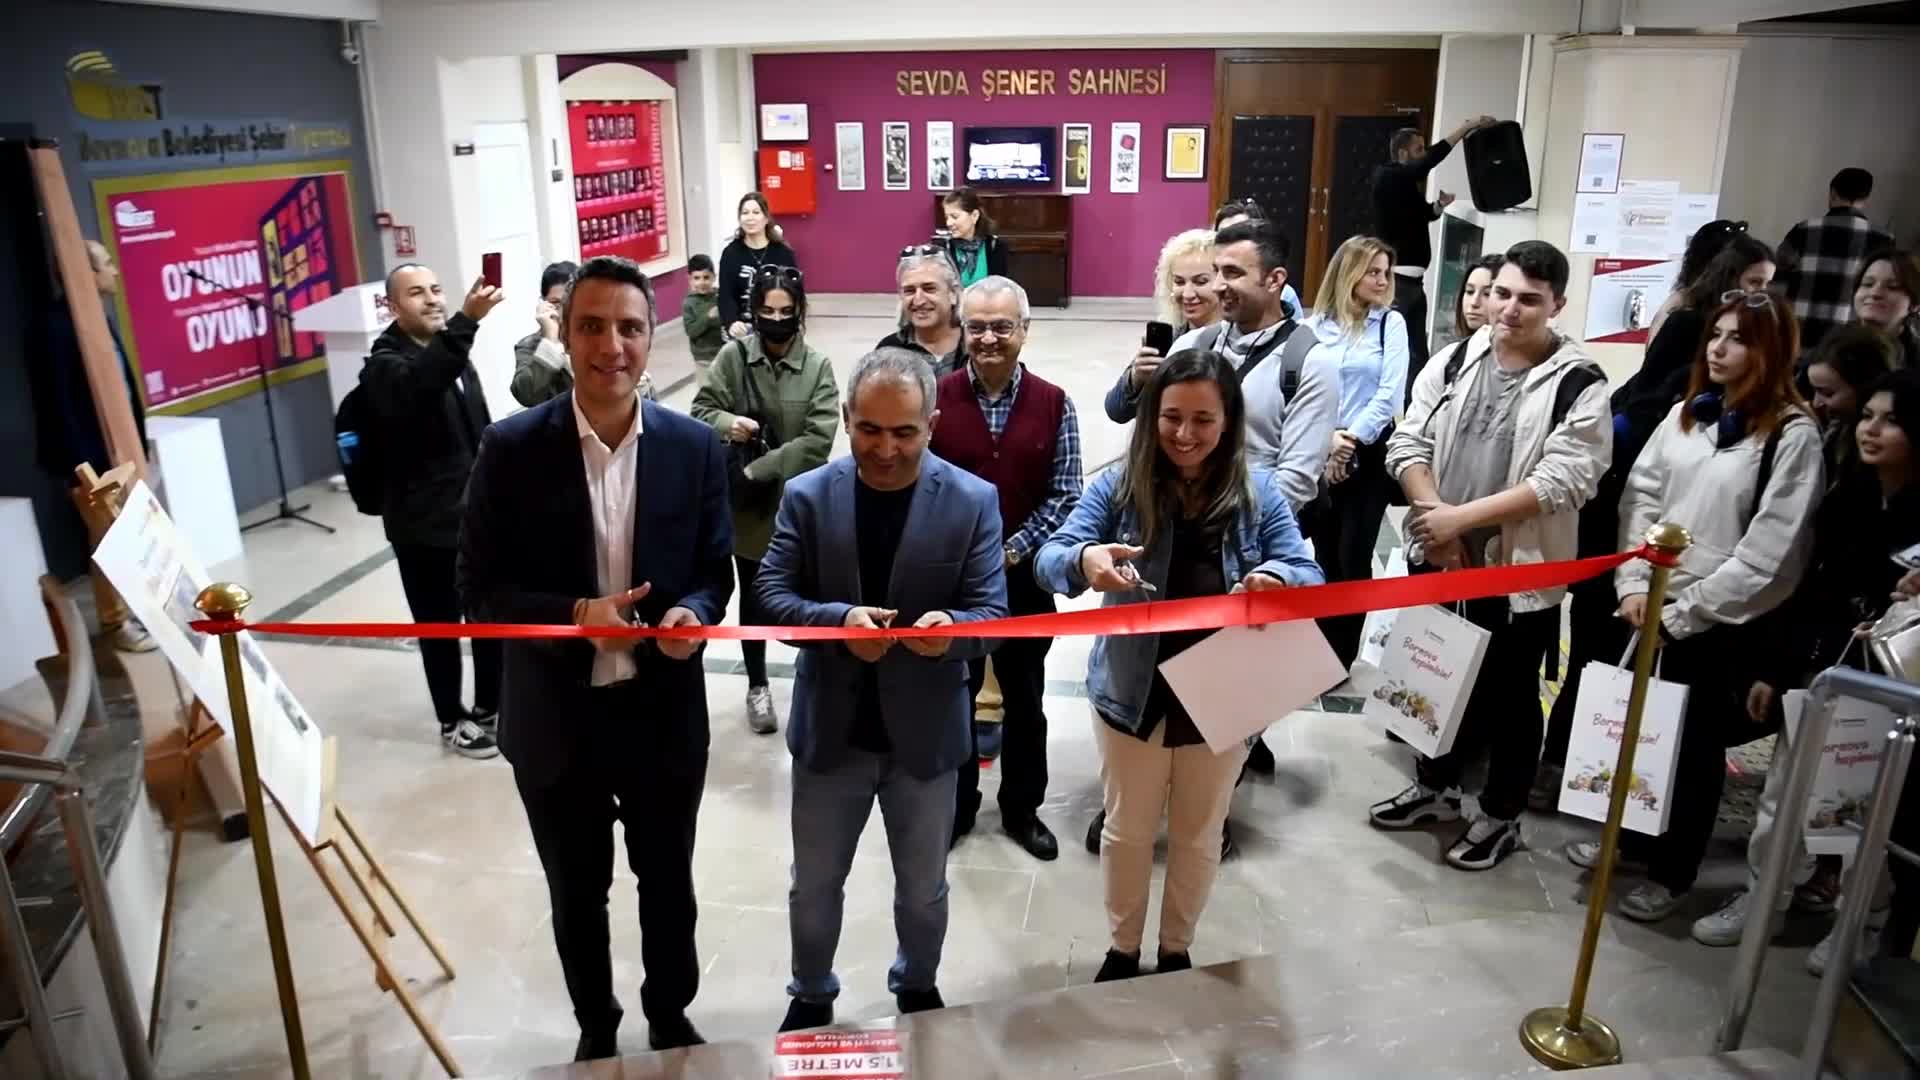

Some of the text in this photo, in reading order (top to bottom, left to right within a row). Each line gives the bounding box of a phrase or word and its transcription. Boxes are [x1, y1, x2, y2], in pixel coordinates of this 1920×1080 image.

[896, 63, 1168, 101] SEVDA ŞENER SAHNESİ
[161, 249, 263, 302] OYUNUN
[788, 1057, 863, 1071] METRE
